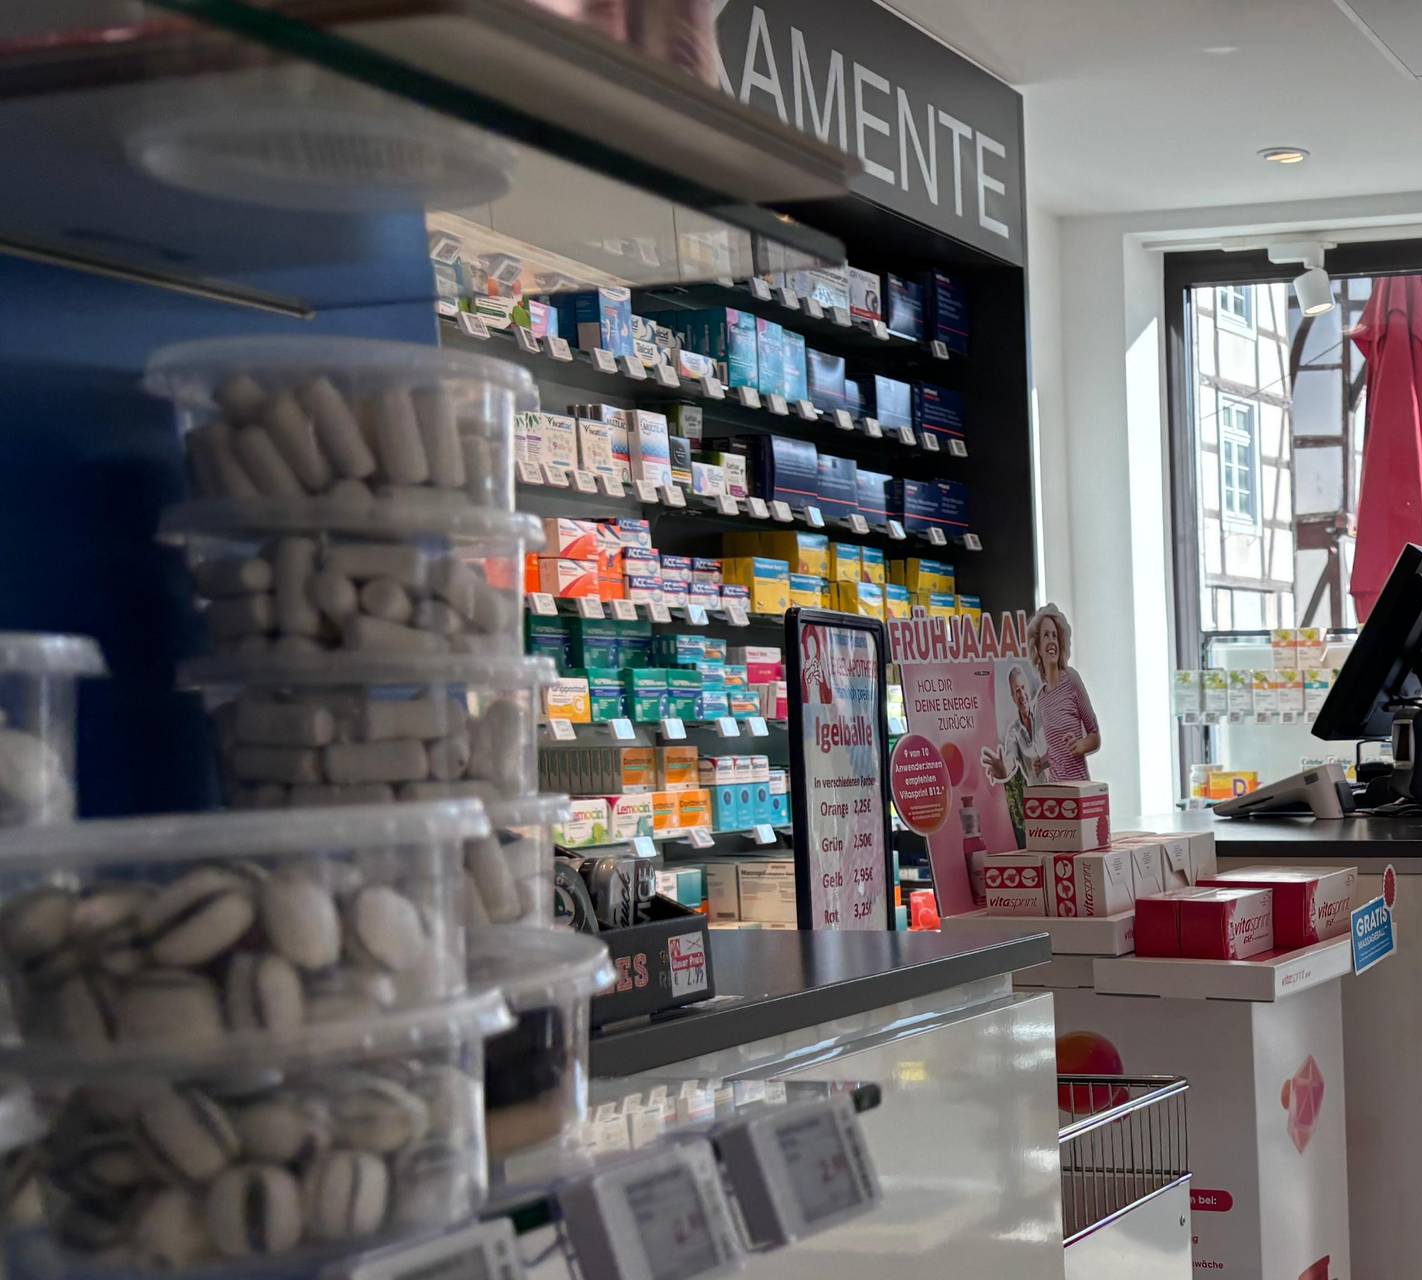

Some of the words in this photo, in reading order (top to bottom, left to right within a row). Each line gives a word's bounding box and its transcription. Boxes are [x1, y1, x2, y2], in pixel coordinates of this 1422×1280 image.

[889, 609, 1029, 662] FRÜHJAAA!
[917, 679, 935, 693] HOL
[938, 678, 953, 693] DIR
[915, 698, 941, 713] DEINE
[943, 696, 979, 712] ENERGIE
[815, 715, 873, 754] Igelbälle
[900, 788, 929, 801] Vitasprint
[617, 803, 650, 816] Lemocin
[820, 801, 849, 818] Orange
[854, 798, 872, 815] 2,25€
[821, 837, 844, 853] Grün
[853, 832, 873, 849] 2,50€
[1028, 826, 1078, 842] vitasprint
[822, 872, 844, 889] Gelb
[853, 867, 874, 886] 2,95€
[1082, 862, 1096, 917] vitasprint
[989, 895, 1039, 912] vitasprint
[1317, 897, 1351, 920] vitasprint
[824, 909, 840, 925] Rot
[1233, 911, 1271, 938] vitasprint
[1355, 906, 1389, 938] GRATIS
[1198, 1195, 1217, 1206] bei:
[1192, 1259, 1224, 1270] wäche
